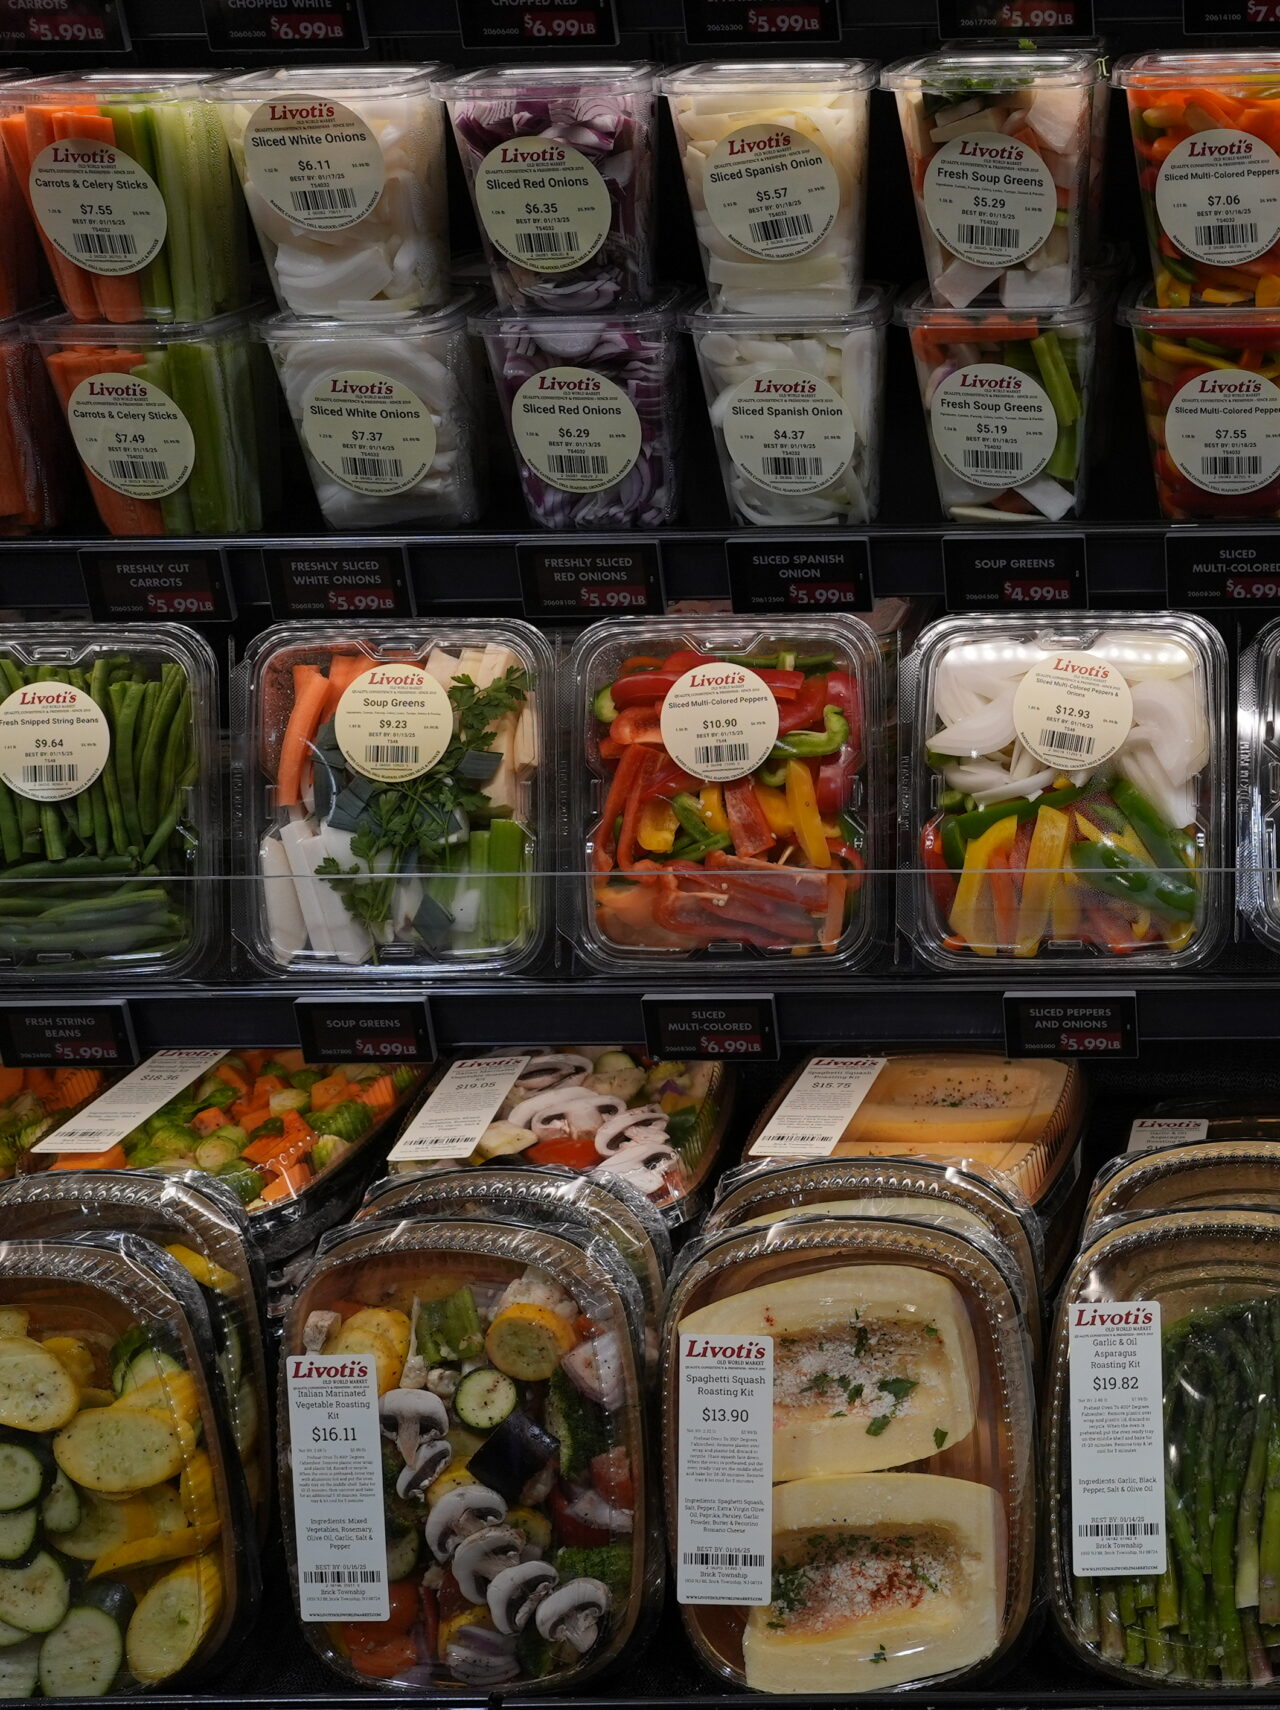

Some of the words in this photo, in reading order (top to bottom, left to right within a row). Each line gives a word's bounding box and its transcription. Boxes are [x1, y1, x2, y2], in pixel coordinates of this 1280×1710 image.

[52, 148, 115, 163] Livoti's
[501, 146, 565, 164] Livoti's
[959, 141, 1023, 161] Livoti's
[938, 167, 968, 180] Fresh
[972, 171, 1000, 185] Soup
[1004, 175, 1043, 187] Greens
[35, 178, 70, 188] Carrots
[73, 179, 80, 188] &
[82, 180, 113, 191] Celery
[116, 180, 148, 189] Sticks
[487, 178, 520, 190] Sliced
[523, 178, 545, 188] Red
[548, 177, 589, 188] Onions
[974, 196, 1005, 208] $5.29
[80, 204, 112, 215] $7.55
[525, 203, 557, 214] $6.35
[331, 380, 393, 394] Livoti's
[754, 380, 816, 393] Livoti's
[1199, 380, 1261, 393] Livoti's
[310, 406, 343, 416] Sliced
[346, 408, 377, 418] White
[380, 409, 420, 418] Onions
[732, 406, 764, 415] Sliced
[767, 407, 808, 417] Spanish
[812, 407, 842, 416] Onion
[352, 430, 382, 441] $7.37
[774, 430, 804, 440] $4.37
[1216, 429, 1247, 439] $7.55
[753, 556, 789, 564] SLICED
[793, 555, 844, 564] SPANISH
[975, 560, 1006, 568] SOUP
[1011, 559, 1055, 568] GREENS
[116, 564, 163, 573] FRESHLY
[168, 564, 189, 572] CUT
[779, 569, 820, 578] ONION
[130, 578, 182, 587] CARROTS
[368, 673, 424, 685] Livoti's
[363, 698, 388, 708] Soup
[391, 699, 425, 707] Greens
[380, 720, 407, 729] $9.23
[1075, 1308, 1152, 1328] Livoti's
[1093, 1338, 1117, 1346] Garlic
[686, 1340, 765, 1359] Livoti's
[1094, 1351, 1136, 1359] Asparagus
[686, 1374, 729, 1384] Spaghetti
[732, 1376, 765, 1385] Squash
[1093, 1376, 1138, 1391] $19.82
[698, 1387, 738, 1397] Roasting
[741, 1388, 753, 1396] Kit
[703, 1407, 748, 1422] $13.90
